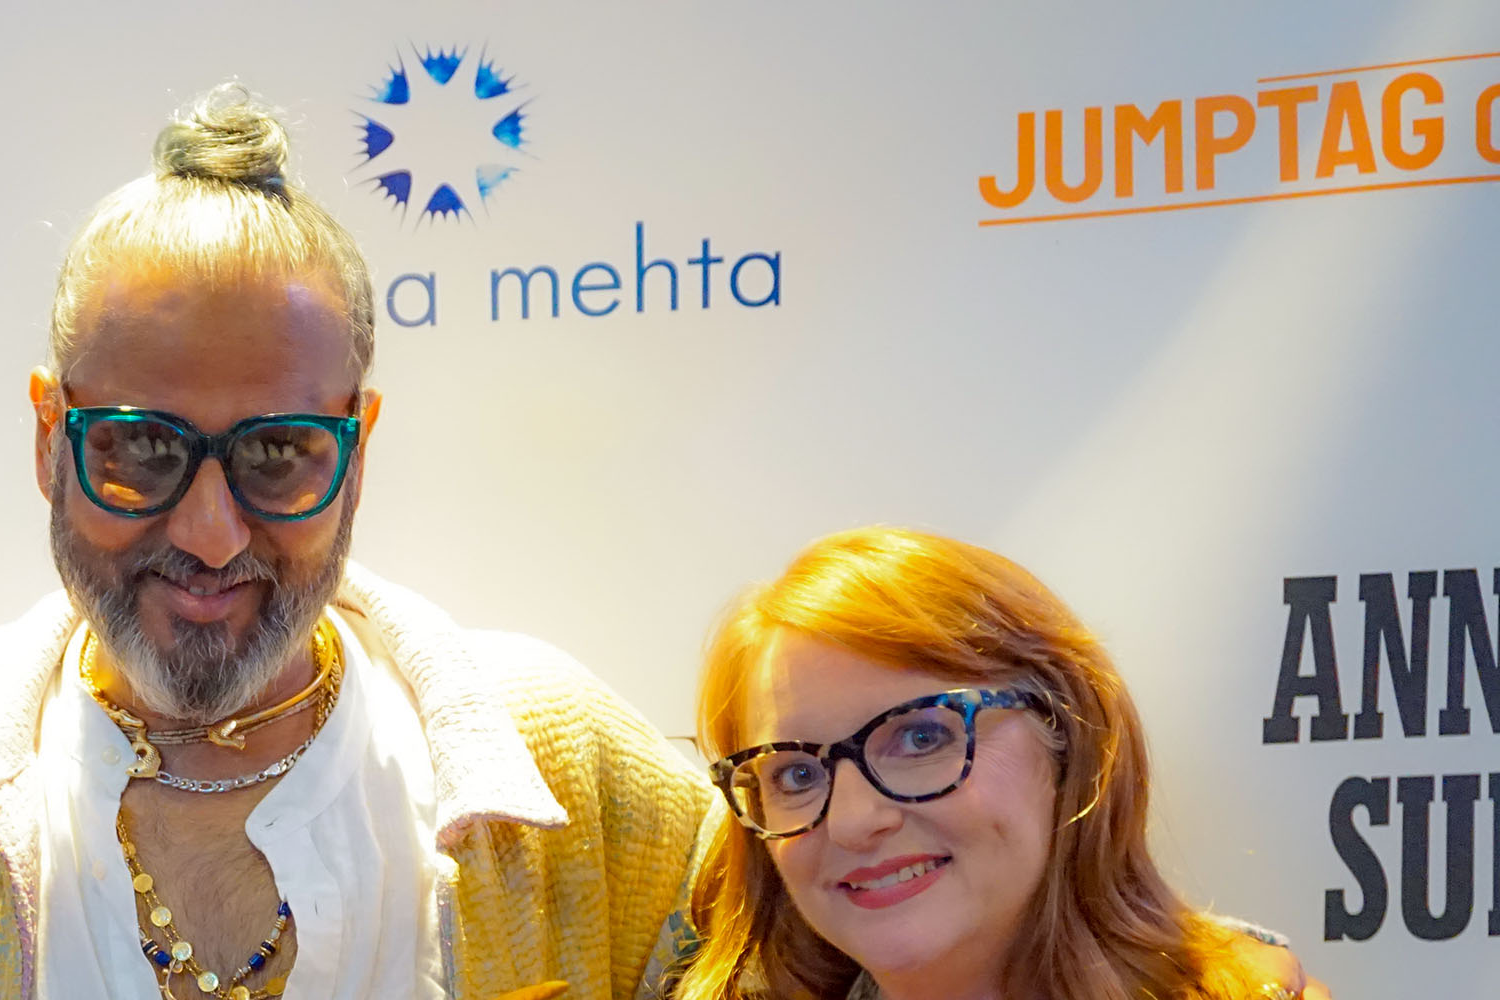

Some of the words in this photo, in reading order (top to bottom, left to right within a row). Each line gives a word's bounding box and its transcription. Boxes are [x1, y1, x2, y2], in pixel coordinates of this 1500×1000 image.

[978, 72, 1444, 209] JUMPTAG
[489, 221, 782, 322] mehta
[1262, 567, 1500, 744] ANN
[1324, 772, 1500, 942] SU
